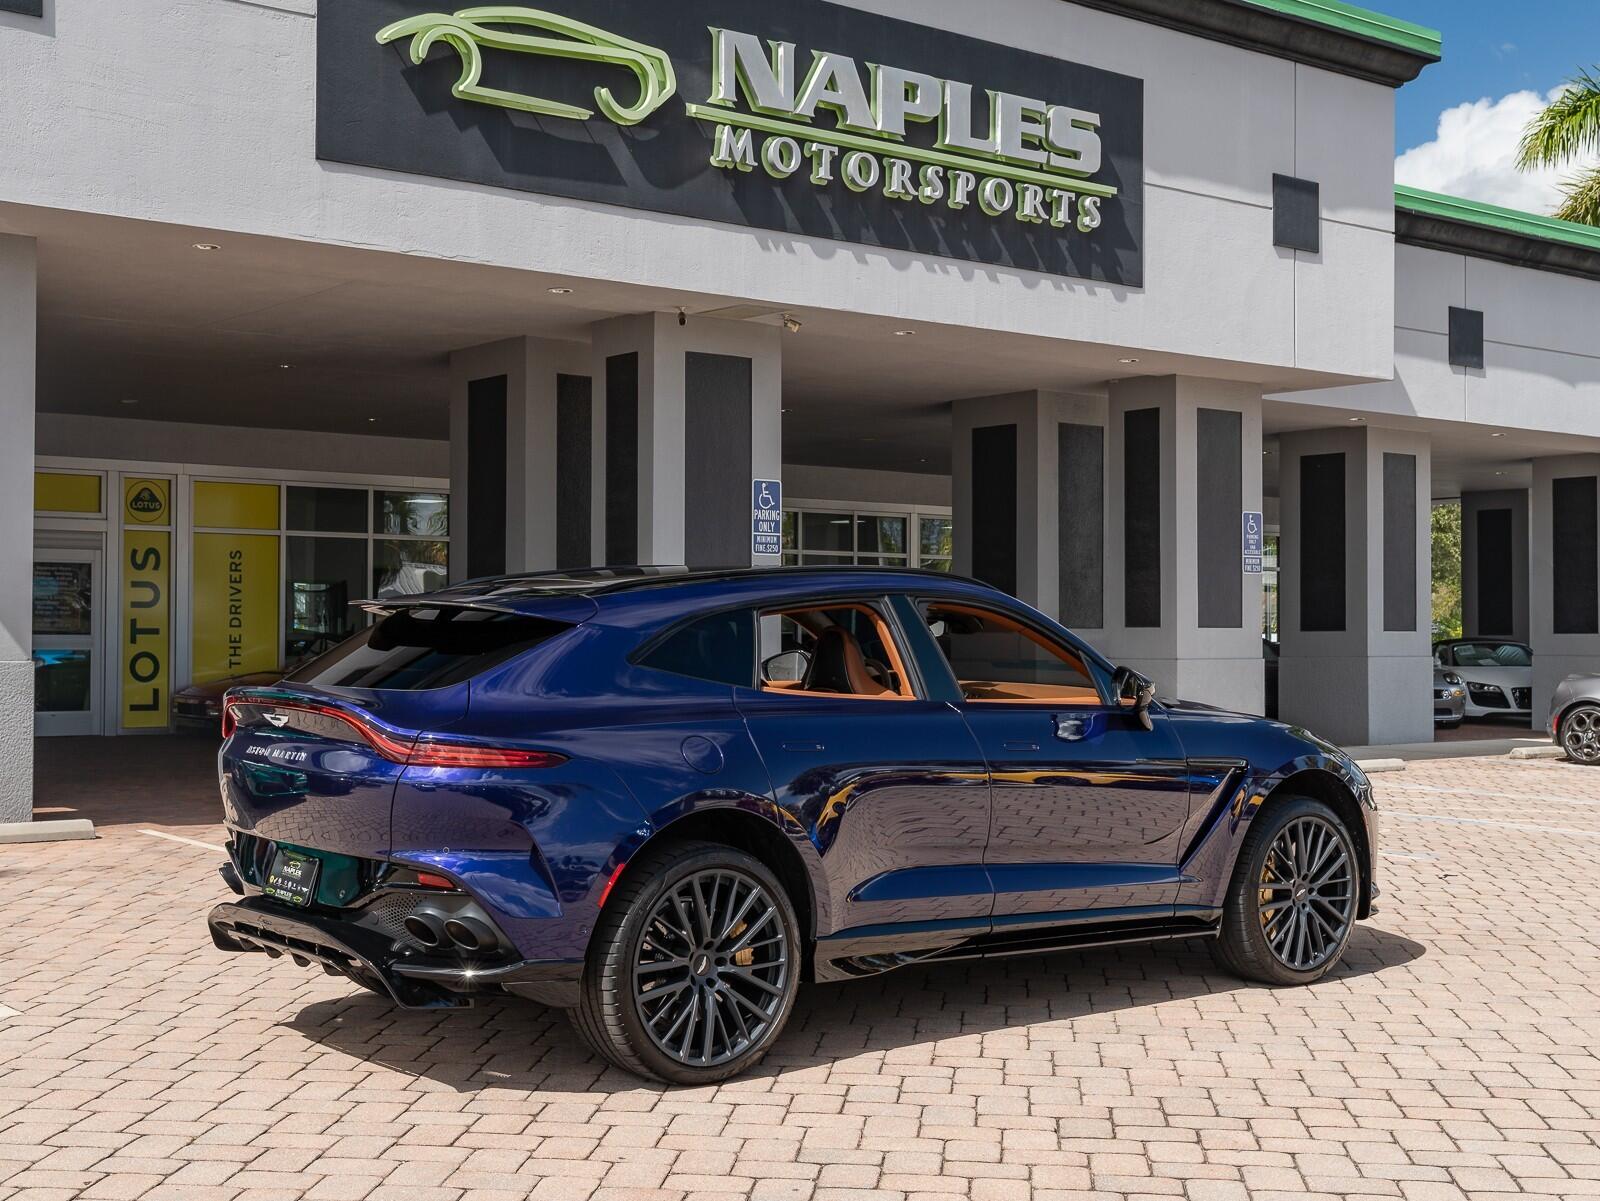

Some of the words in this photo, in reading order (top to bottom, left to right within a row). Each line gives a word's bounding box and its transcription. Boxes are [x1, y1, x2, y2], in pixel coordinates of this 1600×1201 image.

[707, 26, 1102, 176] NAPLES
[710, 125, 1102, 232] MOTORSPORTS
[132, 501, 161, 510] LOTUS
[754, 509, 780, 521] PARKING
[756, 535, 778, 544] MINIMUM
[758, 521, 776, 533] ONLY
[229, 550, 243, 629] DRIVERS
[129, 547, 161, 712] LOTUS
[229, 634, 242, 669] THE
[246, 745, 271, 757] ASTON
[271, 749, 308, 761] MARTIN
